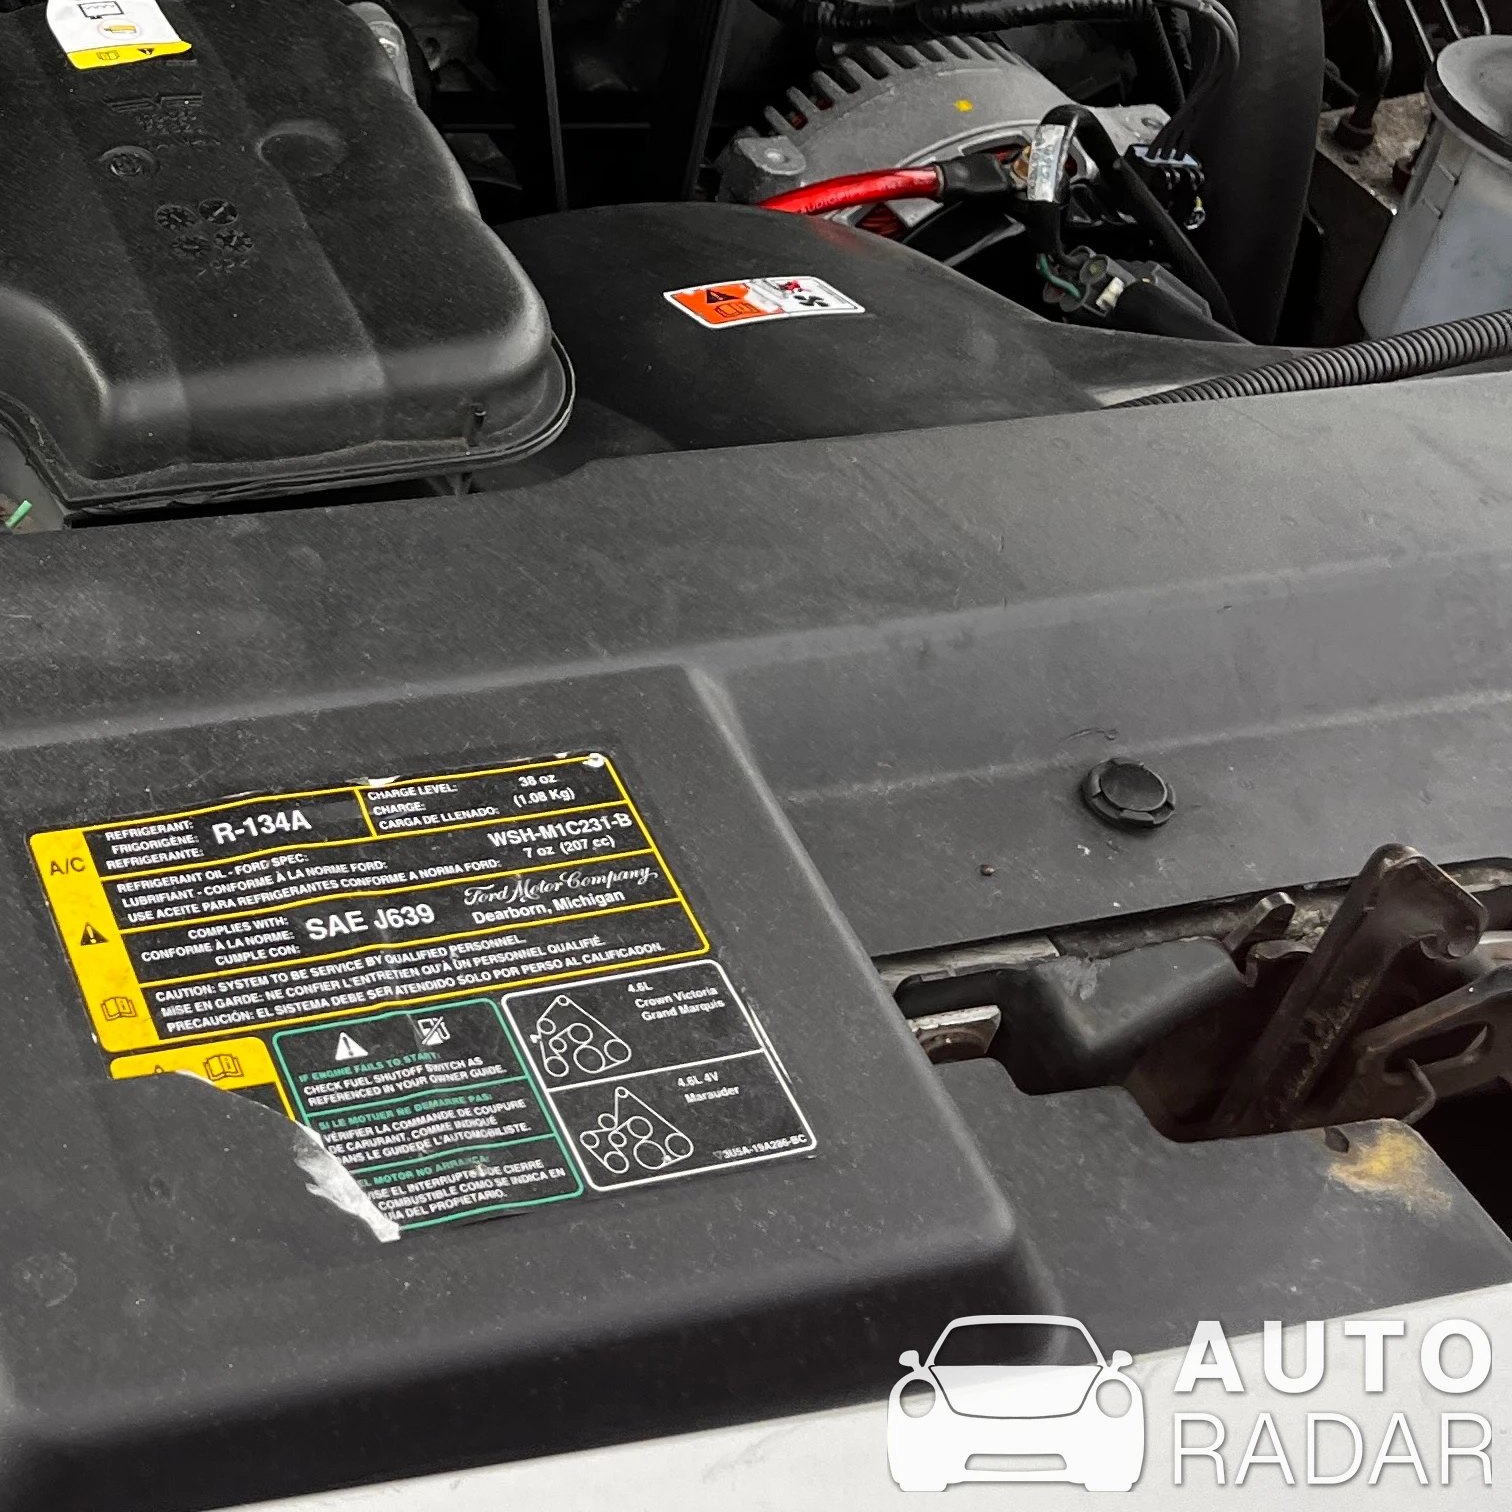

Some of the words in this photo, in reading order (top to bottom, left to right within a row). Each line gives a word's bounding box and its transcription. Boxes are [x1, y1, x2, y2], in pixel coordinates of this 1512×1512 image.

[367, 786, 418, 801] CHARGE
[417, 783, 459, 796] LEVEL:
[518, 775, 538, 787] 38
[538, 774, 558, 785] oz
[372, 801, 427, 816] CHARGE:
[513, 791, 548, 808] (1.08
[548, 786, 575, 801] Kg)
[211, 809, 313, 845] R-134A
[378, 816, 423, 830] CARGA
[421, 814, 441, 825] DE
[439, 806, 500, 822] LLENADO:
[487, 812, 633, 847] WSH-M1C231-B
[104, 820, 194, 842] REFRIGERANT:
[111, 834, 200, 855] FRIGORIGÈNE:
[522, 847, 532, 859] 7
[536, 846, 556, 857] oz
[559, 838, 588, 856] (207
[50, 856, 86, 876] A/C
[105, 847, 205, 870] REFRIGERANTE:
[116, 872, 203, 894] REFRIGERANT
[204, 869, 227, 881] OIL
[234, 859, 270, 876] FORD
[270, 852, 309, 868] SPEC:
[121, 888, 194, 908] LUBRIFIANT
[203, 874, 275, 896] CONFORME
[275, 870, 287, 883] À
[286, 868, 305, 881] LA
[304, 863, 350, 877] NORME
[349, 860, 388, 873] FORD:
[127, 910, 155, 923] USE
[156, 903, 201, 919] ACEITE
[201, 898, 237, 912] PARA
[236, 879, 340, 906] REFRIGERANTES
[339, 872, 408, 888] CONFORME
[409, 871, 419, 881] A
[418, 864, 464, 879] NORMA
[463, 858, 502, 872] FORD:
[463, 883, 514, 906] Ford
[499, 874, 564, 904] Motor
[558, 867, 659, 889] Company
[471, 903, 553, 925] Dearborn,
[551, 891, 626, 911] Michigan
[187, 921, 252, 940] COMPLIES
[251, 916, 289, 930] WITH:
[305, 910, 369, 940] SAE
[373, 903, 435, 930] J639
[140, 942, 214, 962] CONFORME
[214, 938, 226, 951] À
[225, 938, 245, 949] LA
[244, 930, 295, 946] NORME:
[214, 948, 268, 966] CUMPLE
[268, 944, 301, 958] CON:
[155, 984, 217, 1002] CAUTION:
[217, 975, 270, 993] SYSTEM
[269, 972, 289, 984] TO
[289, 968, 310, 981] BE
[309, 958, 365, 978] SERVICE
[364, 954, 382, 967] BY
[383, 946, 448, 965] QUALIFIED
[448, 934, 527, 957] PERSONNEL.
[160, 1003, 194, 1018] MISE
[193, 999, 214, 1012] EN
[214, 992, 265, 1009] GARDE:
[264, 988, 285, 1001] NE
[285, 980, 342, 998] CONFIER
[341, 967, 421, 989] L'ENTRETIEN
[420, 959, 453, 975] QU'À
[451, 958, 472, 970] UN
[472, 946, 547, 967] PERSONNEL
[546, 934, 606, 954] QUALIFIÉ.
[166, 1009, 255, 1033] PRECAUCIÓN:
[255, 1007, 275, 1019] EL
[274, 998, 331, 1016] SISTEMA
[330, 991, 367, 1007] DEBE
[366, 985, 394, 1000] SER
[395, 977, 456, 996] ATENDIDO
[456, 971, 492, 986] SOLO
[492, 966, 521, 980] POR
[520, 958, 564, 975] PERSO
[565, 956, 583, 968] AL
[627, 981, 654, 993] 4.6L
[634, 995, 674, 1009] Crown
[672, 986, 719, 1002] Victoria
[641, 1006, 678, 1021] Grand
[677, 999, 726, 1015] Marquis
[298, 1073, 309, 1083] IF
[311, 1066, 353, 1081] ENGINE
[353, 1061, 385, 1074] FAILS
[385, 1058, 402, 1068] TO
[402, 1051, 441, 1064] START:
[303, 1081, 344, 1096] CHECK
[342, 1076, 373, 1089] FUEL
[372, 1064, 423, 1084] SHUTOFF
[424, 1059, 467, 1077] SWITCH
[467, 1056, 484, 1067] AS
[677, 1075, 704, 1087] 4.6L
[703, 1071, 719, 1083] 4V
[307, 1086, 382, 1107] REFERENCED
[381, 1083, 396, 1094] IN
[395, 1075, 429, 1091] YOUR
[428, 1070, 469, 1084] OWNER
[469, 1064, 507, 1078] GUIDE.
[684, 1086, 740, 1104] Marauder
[322, 1126, 375, 1143] VÉRIFIER
[374, 1123, 392, 1135] LA
[391, 1109, 457, 1131] COMMANDE
[455, 1107, 474, 1118] DE
[472, 1098, 527, 1116] COUPURE
[410, 1121, 454, 1140] COMME
[453, 1114, 498, 1134] INDIQUÉ
[364, 1149, 382, 1161] LE
[377, 1185, 459, 1213] COMBUSTIBLE
[458, 1178, 494, 1193] COMO
[493, 1176, 511, 1187] SE
[509, 1171, 549, 1185] INDICA
[548, 1167, 566, 1179] EN
[390, 1185, 407, 1196] EL
[484, 1165, 503, 1176] DE
[502, 1159, 545, 1175] CIERRE
[404, 1205, 430, 1218] DEL
